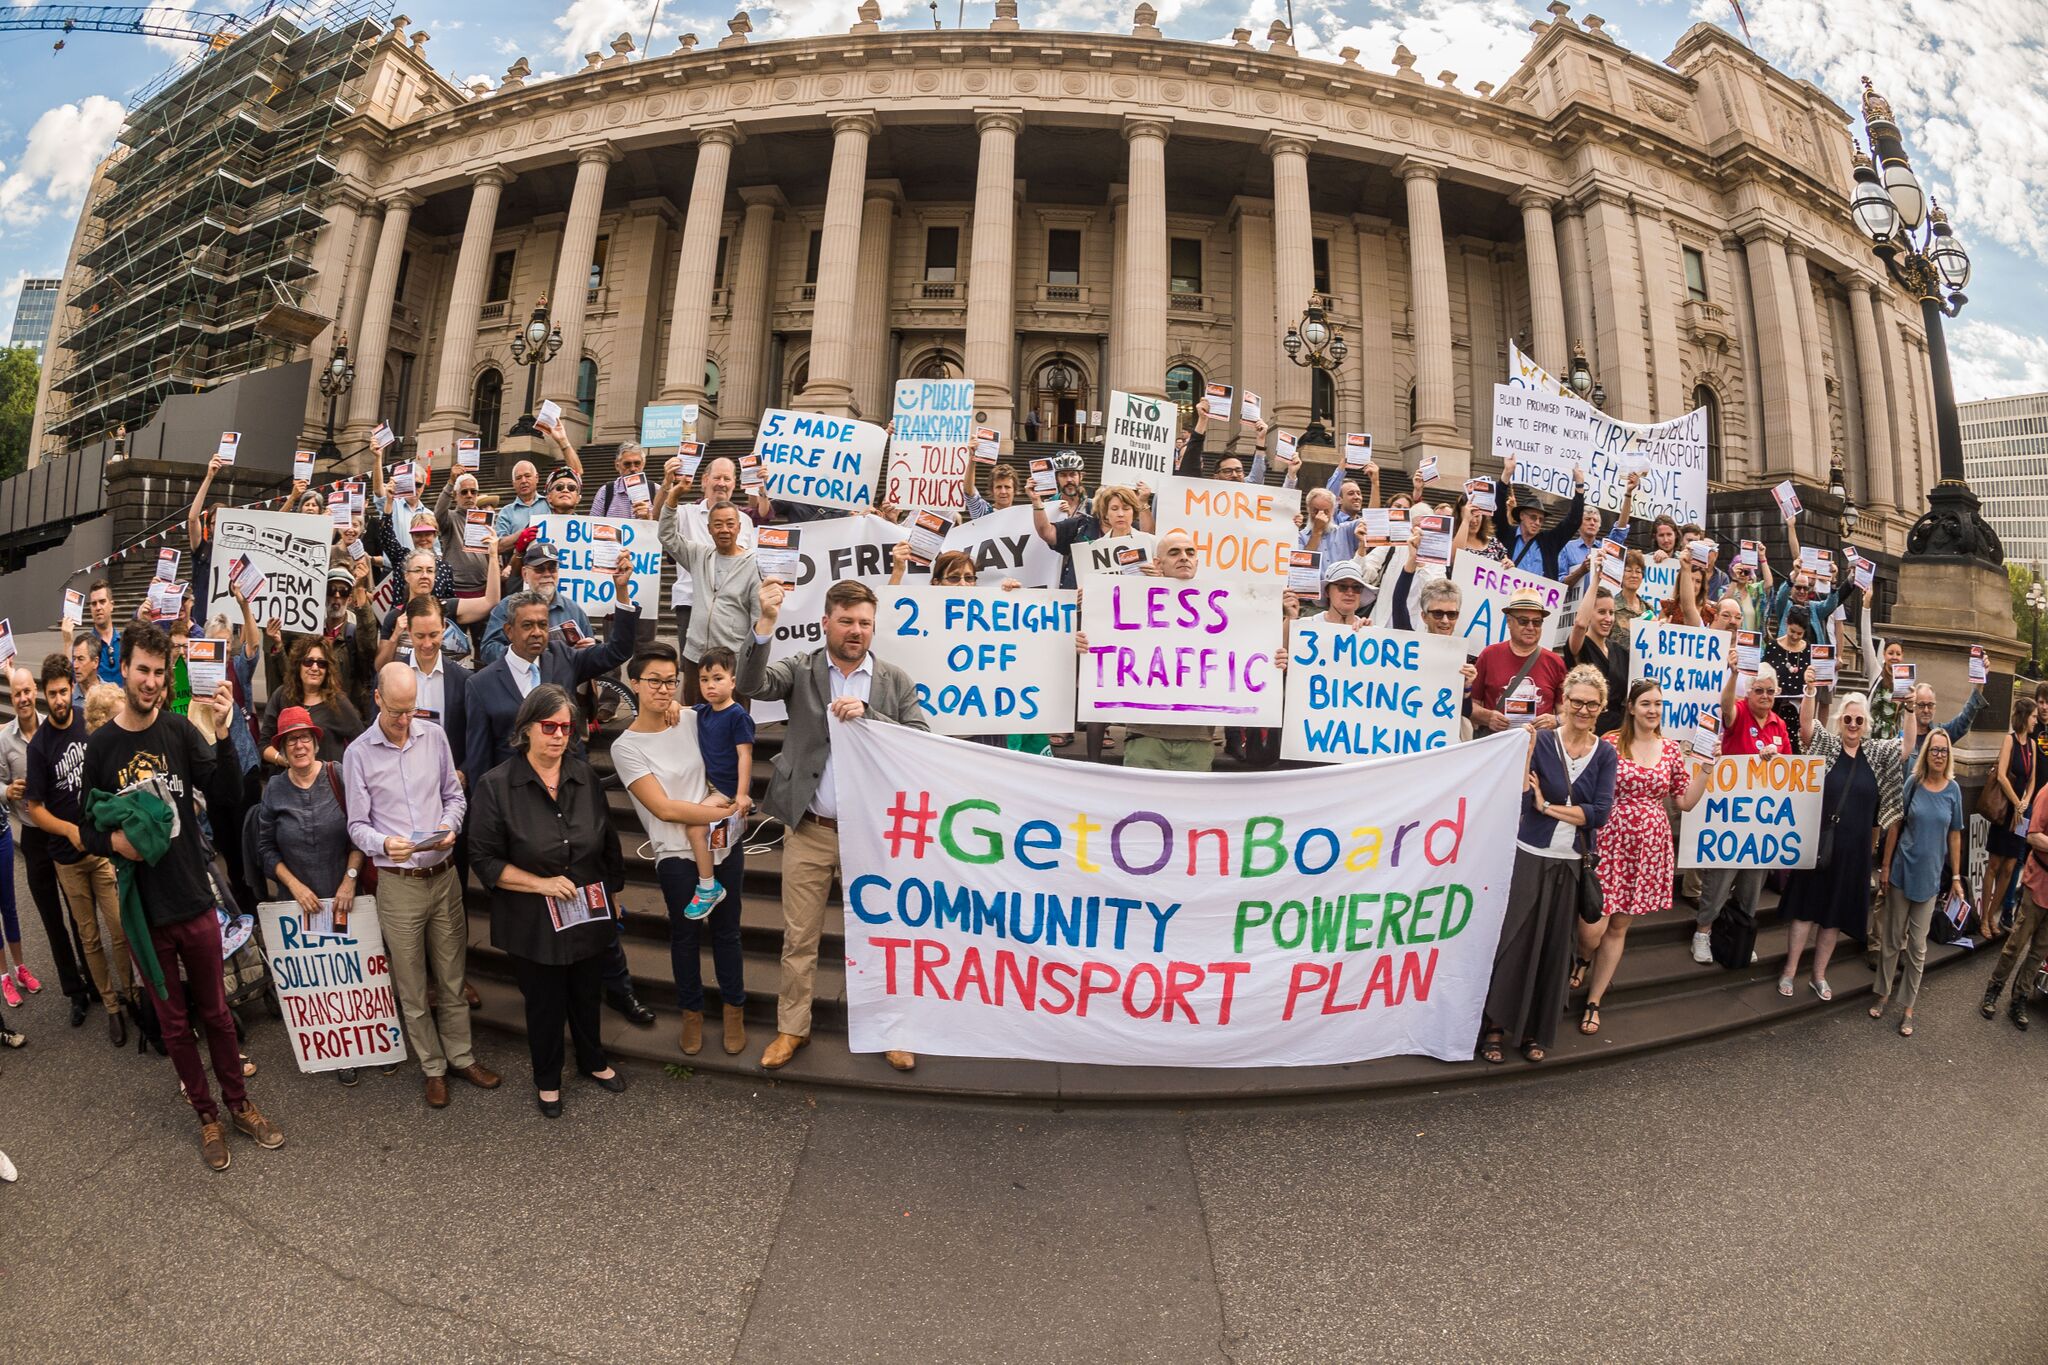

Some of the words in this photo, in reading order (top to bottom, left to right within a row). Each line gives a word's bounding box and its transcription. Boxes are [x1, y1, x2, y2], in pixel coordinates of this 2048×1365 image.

[921, 383, 974, 411] PUBLIC
[1126, 401, 1161, 422] NO
[1499, 393, 1521, 407] BUILD
[1526, 398, 1560, 415] PROMISED
[1564, 405, 1587, 420] TRAIN
[793, 417, 856, 443] MADE
[893, 414, 972, 443] TRANSPORT
[1114, 417, 1169, 444] FREEWAY
[1496, 414, 1514, 428] LINE
[1518, 418, 1529, 430] TO
[1533, 420, 1558, 435] EPPING
[1563, 428, 1589, 441] NORTH
[761, 442, 825, 468] HERE
[832, 450, 862, 476] IN
[921, 445, 968, 476] TOLLS
[1111, 447, 1166, 473] BANYULE
[1129, 440, 1151, 451] through
[1496, 436, 1502, 446] &
[1544, 444, 1554, 455] BY
[1560, 447, 1583, 460] 2024
[764, 472, 870, 506] VICTORIA
[889, 477, 900, 504] &
[908, 477, 965, 508] TRUCKS
[1184, 487, 1274, 523] MORE
[566, 520, 635, 547] BUD
[1167, 527, 1291, 576] HOICE
[265, 572, 313, 597] TERM
[253, 595, 320, 632] JOBS
[944, 598, 1077, 634] FREIGHT
[1112, 585, 1230, 635] LESS
[947, 643, 1017, 673] OFF
[1293, 630, 1327, 667] 3.
[1333, 633, 1420, 671] MORE
[1658, 629, 1721, 662] BETTER
[1088, 645, 1269, 693] TRAFFIC
[1674, 667, 1685, 692] &
[1687, 668, 1723, 693] TRAM
[915, 682, 1041, 720] ROADS
[1309, 674, 1424, 719] BIKING
[1432, 687, 1456, 720] &
[1303, 718, 1447, 755] WALKING
[1746, 756, 1825, 793] MORE
[1704, 796, 1796, 827] MEGA
[883, 790, 1468, 878] #GetOnBoard
[1696, 828, 1802, 866] ROADS
[848, 873, 1181, 953] COMMUNITY
[1233, 882, 1474, 954] POWERED
[273, 950, 363, 990] SOLUTION
[367, 955, 388, 976] OR
[868, 935, 1250, 1026] TRANSPORT
[1281, 946, 1440, 1022] PLAN
[283, 985, 395, 1028] TRANSURBAN
[299, 1022, 400, 1061] PROFITS?
